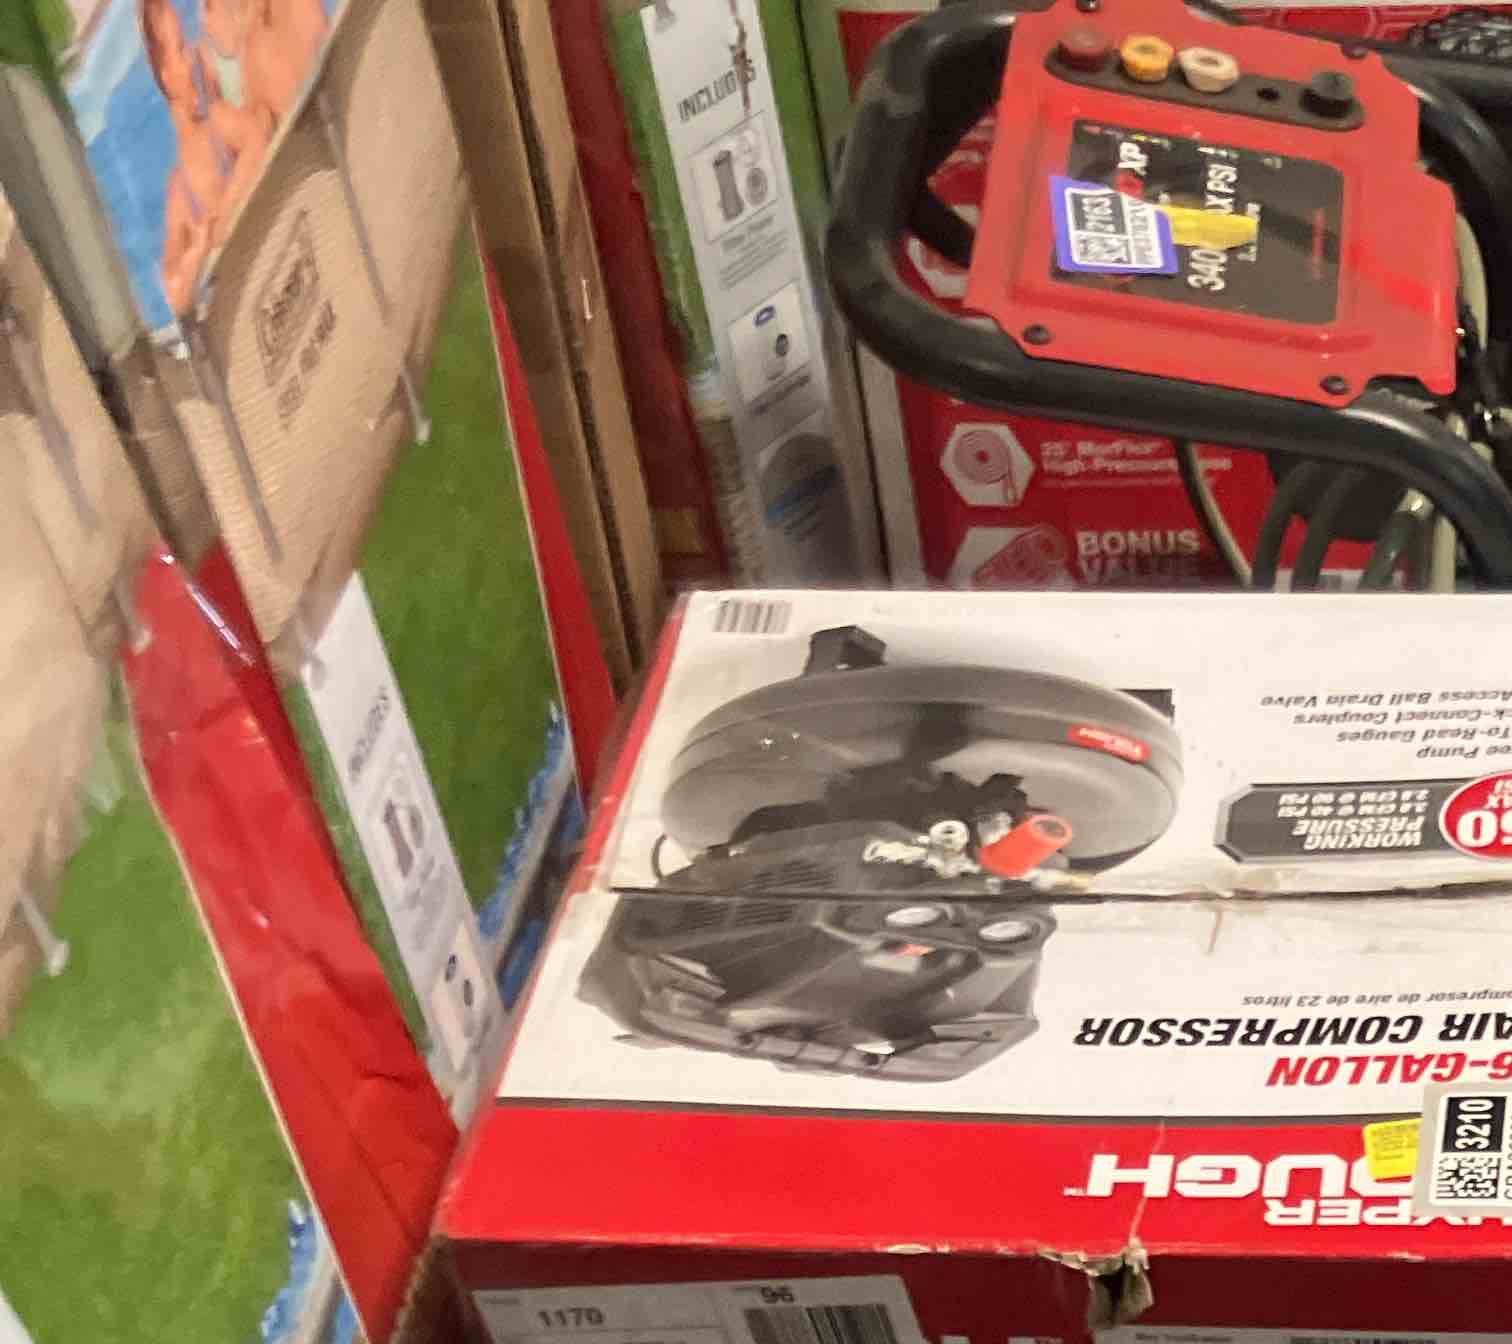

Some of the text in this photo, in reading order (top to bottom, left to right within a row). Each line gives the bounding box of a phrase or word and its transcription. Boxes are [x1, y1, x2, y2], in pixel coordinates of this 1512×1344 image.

[1206, 163, 1238, 194] PSI
[1077, 529, 1202, 556] BONUS
[1261, 695, 1318, 708] Valve
[1327, 692, 1384, 706] Drain
[1390, 691, 1431, 703] Ball
[1416, 744, 1479, 760] Pump
[1292, 816, 1427, 837] PRESSURE
[1304, 831, 1423, 851] WORKING
[1241, 994, 1293, 1009] litros
[1296, 994, 1321, 1007] 23
[1325, 994, 1350, 1007] de
[1355, 993, 1394, 1006] aire
[1398, 992, 1422, 1005] de
[1072, 1013, 1424, 1049] COMPRESSOR
[1455, 1097, 1495, 1152] 3210
